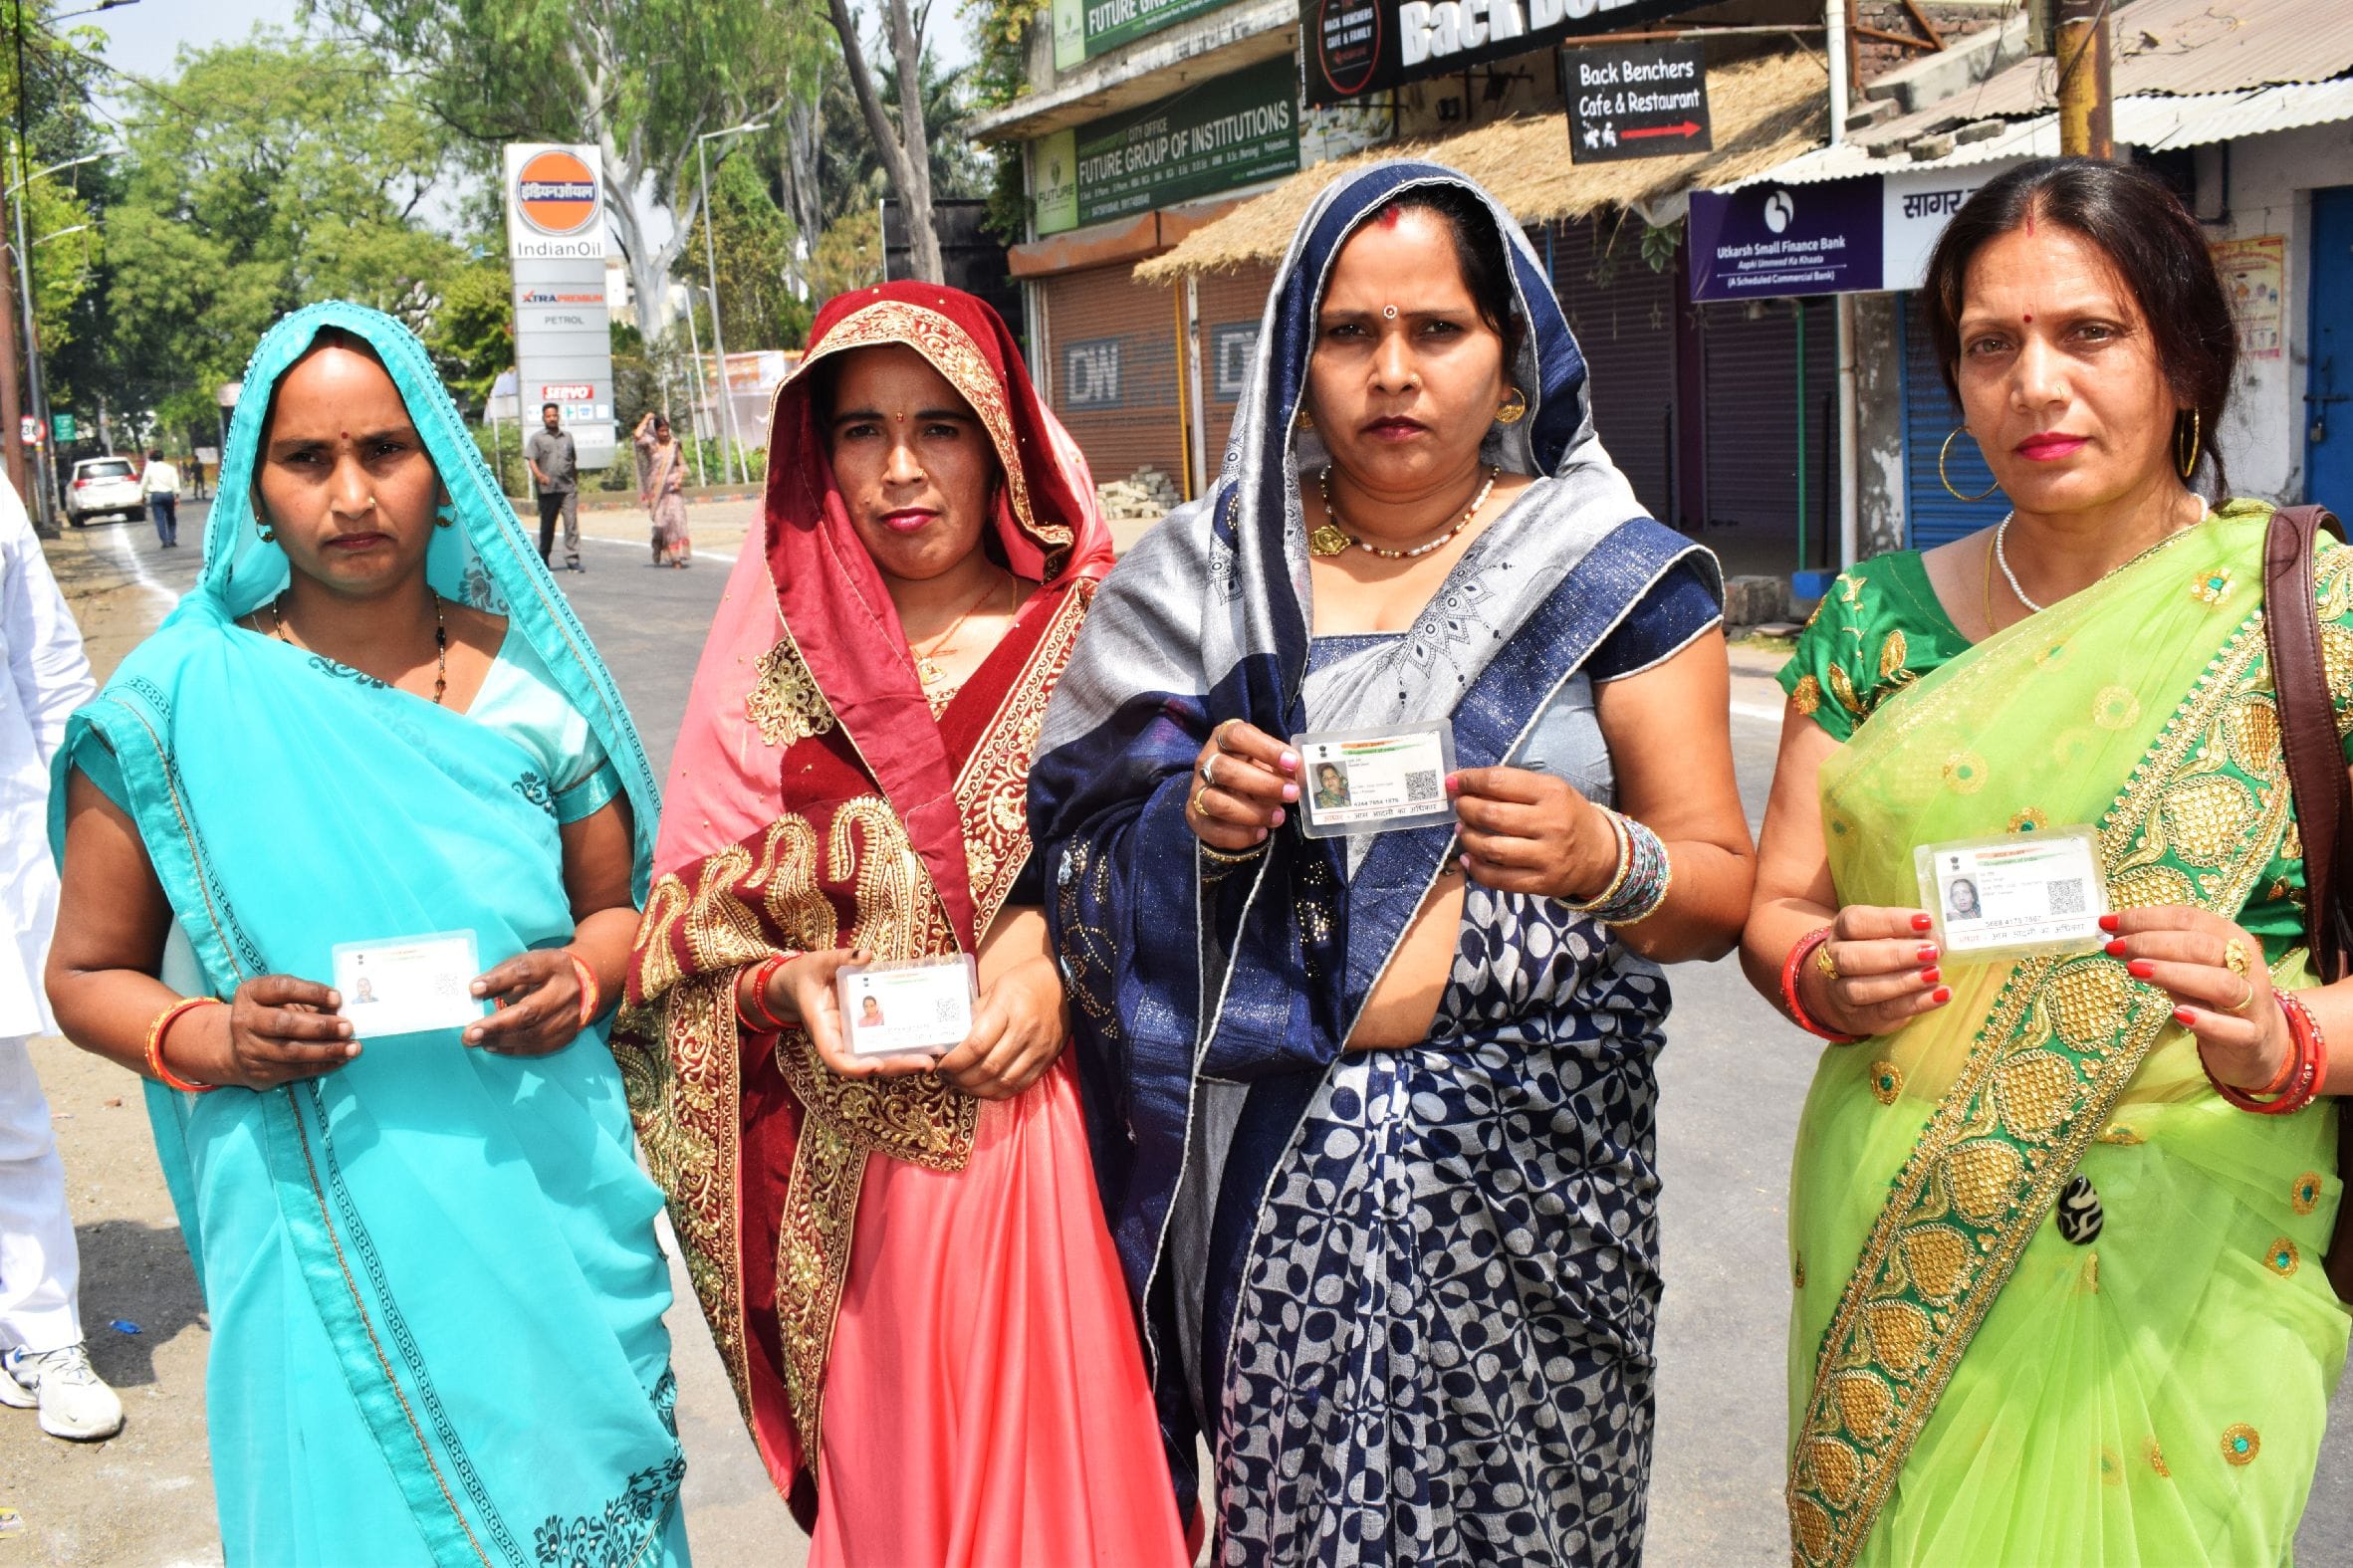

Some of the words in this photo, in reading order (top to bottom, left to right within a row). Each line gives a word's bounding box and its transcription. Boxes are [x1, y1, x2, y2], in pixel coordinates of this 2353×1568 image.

[1088, 0, 1137, 36] FUTURE
[1579, 62, 1619, 87] Back
[1622, 57, 1694, 83] Benchers
[1578, 93, 1613, 117] Cafe
[1614, 92, 1626, 113] &
[1627, 88, 1701, 112] Restaurant
[1128, 125, 1142, 141] CITY
[1144, 116, 1168, 137] OFFICE
[1078, 154, 1123, 186] FUTURE
[1125, 139, 1169, 171] GROUP
[1170, 130, 1188, 159] OF
[1191, 101, 1291, 152] INSTITUTIONS
[522, 182, 593, 200] इंडियनऑयल
[1039, 182, 1074, 203] FUTURE
[1903, 189, 1964, 218] सागर
[518, 242, 600, 256] IndianOil
[1717, 244, 1754, 259] Utkarsh
[1755, 241, 1780, 256] Small
[1781, 240, 1818, 253] Finance
[1820, 235, 1845, 250] Bank
[1736, 275, 1771, 287] Scheduled
[1772, 272, 1813, 284] Commercial
[1813, 270, 1835, 282] Bank)
[545, 316, 585, 326] PETROL
